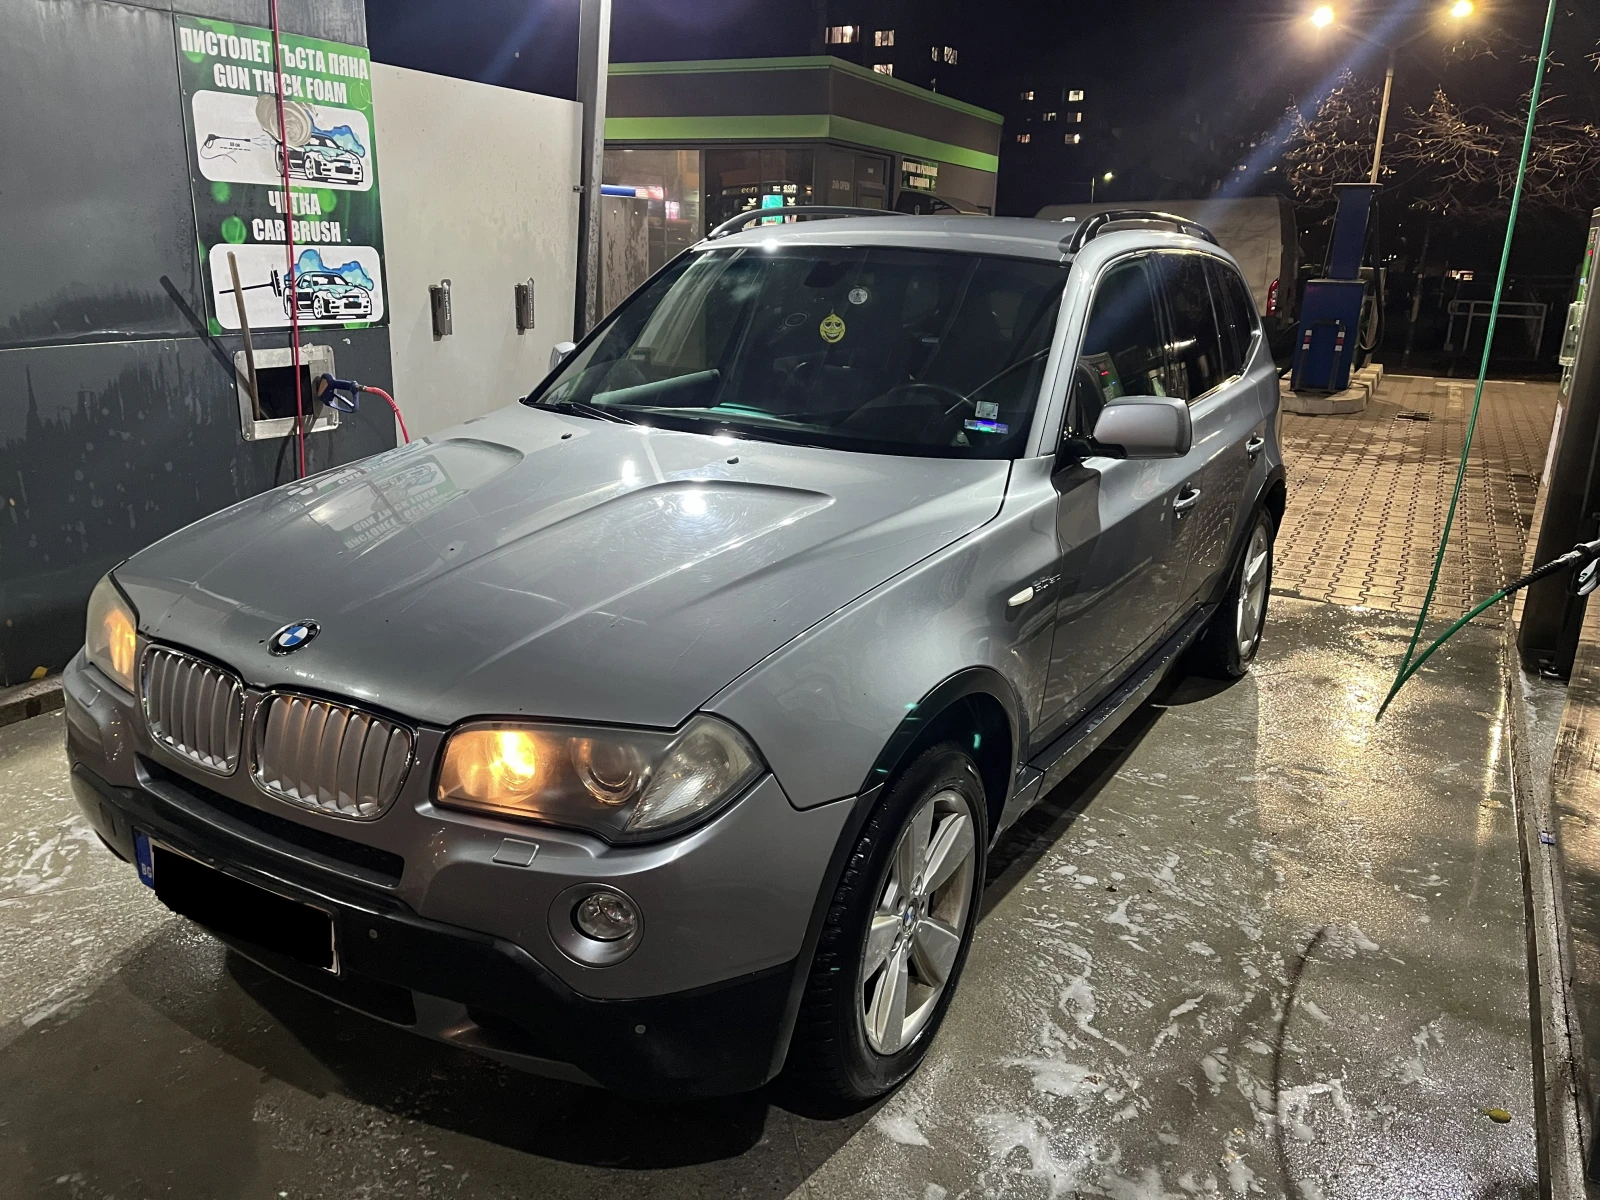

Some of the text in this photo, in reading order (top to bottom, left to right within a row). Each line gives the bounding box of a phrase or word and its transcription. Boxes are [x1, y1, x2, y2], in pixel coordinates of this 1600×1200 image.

[179, 26, 271, 64] ПИСТОЛЕТ
[327, 52, 369, 80] ПЯНА
[213, 63, 251, 91] GUN
[305, 77, 348, 104] FOAM
[252, 218, 341, 242] CAR BRUSH
[141, 862, 153, 878] BG
